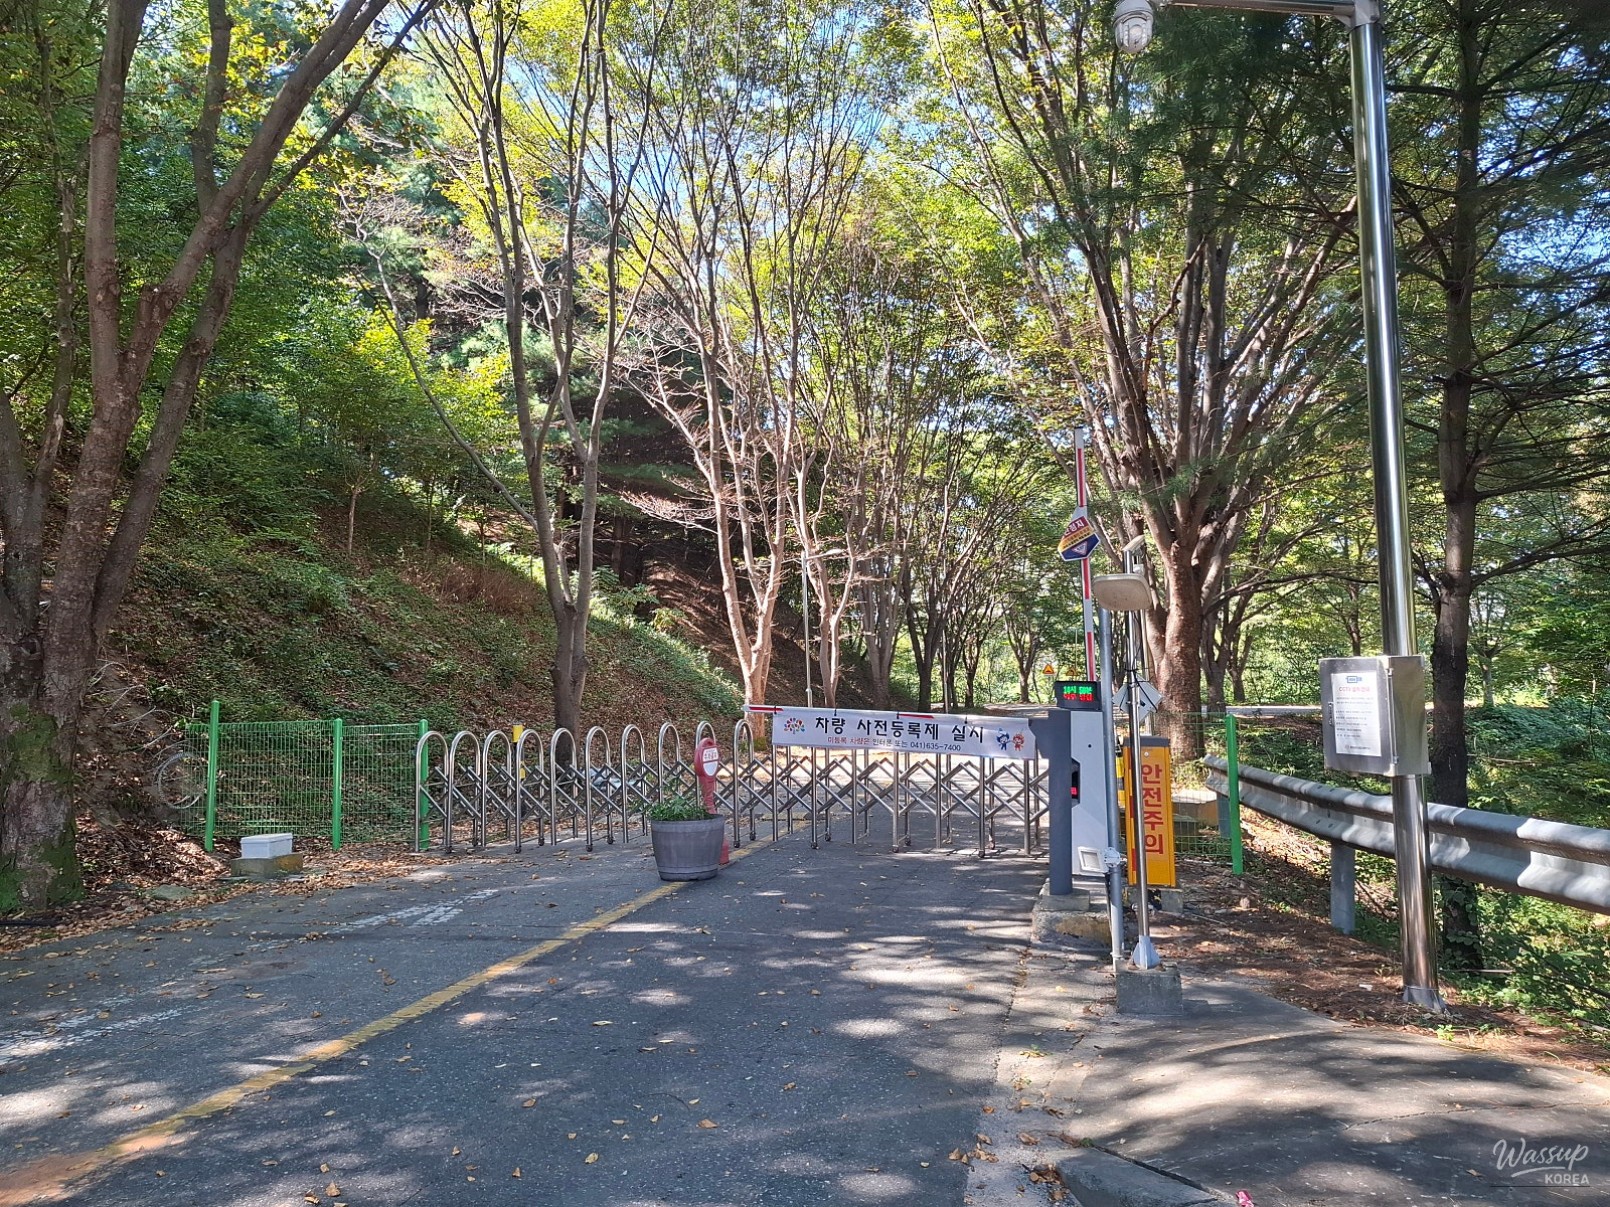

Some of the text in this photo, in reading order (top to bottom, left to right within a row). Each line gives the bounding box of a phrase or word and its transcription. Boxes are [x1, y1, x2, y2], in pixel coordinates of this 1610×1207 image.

[815, 717, 983, 743] 차량 사전등록제 실시
[894, 740, 908, 748] 또는
[910, 742, 961, 751] 041)635-7400
[1141, 763, 1165, 855] 안전주의
